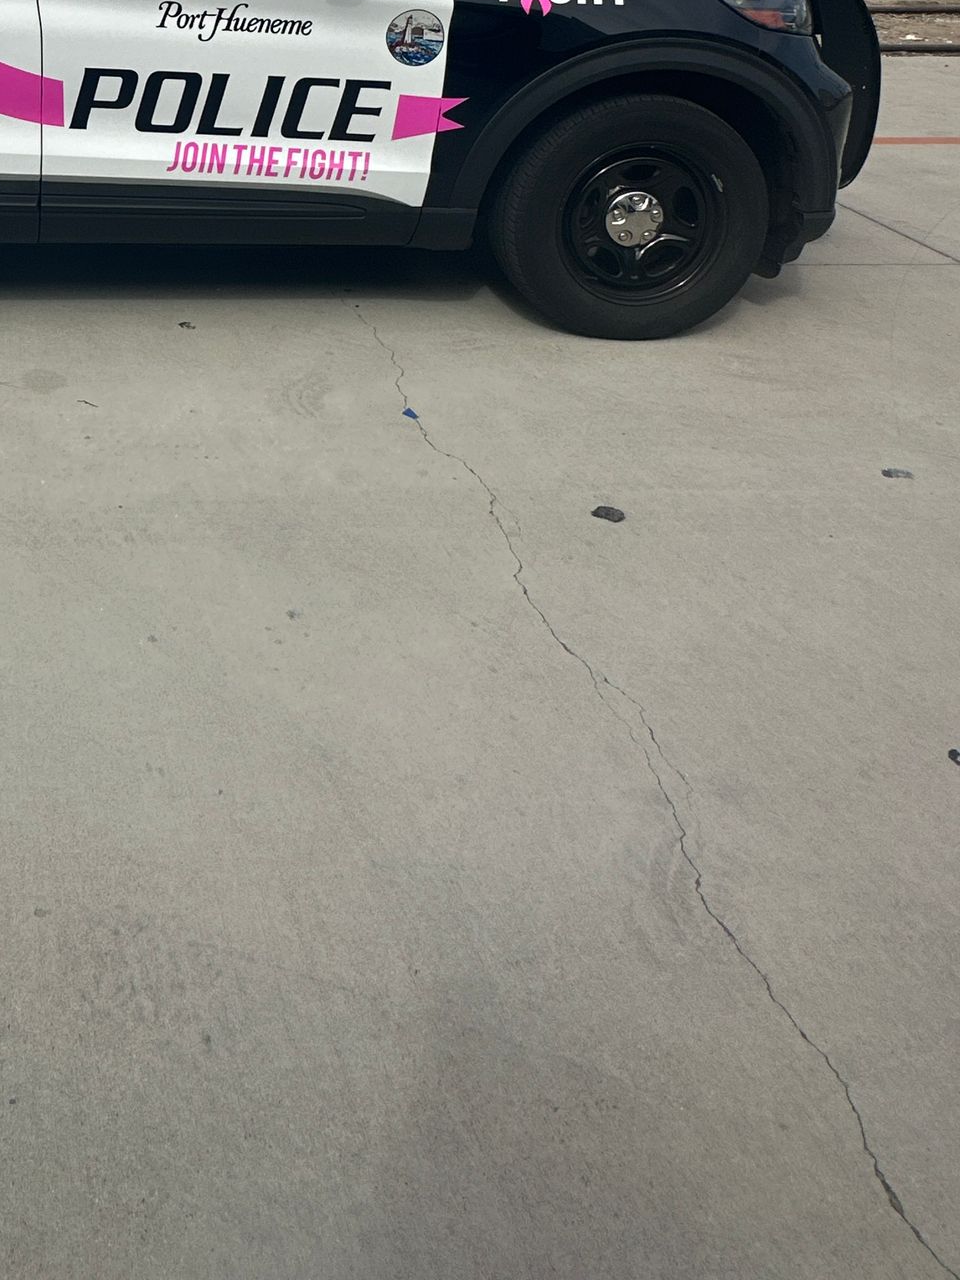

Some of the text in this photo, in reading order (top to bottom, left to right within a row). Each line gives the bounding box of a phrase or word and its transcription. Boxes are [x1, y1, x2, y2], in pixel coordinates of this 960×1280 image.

[155, 0, 313, 42] Port Hueneme
[69, 66, 392, 143] POLICE
[166, 141, 371, 182] JOIN THE FIGHT!
